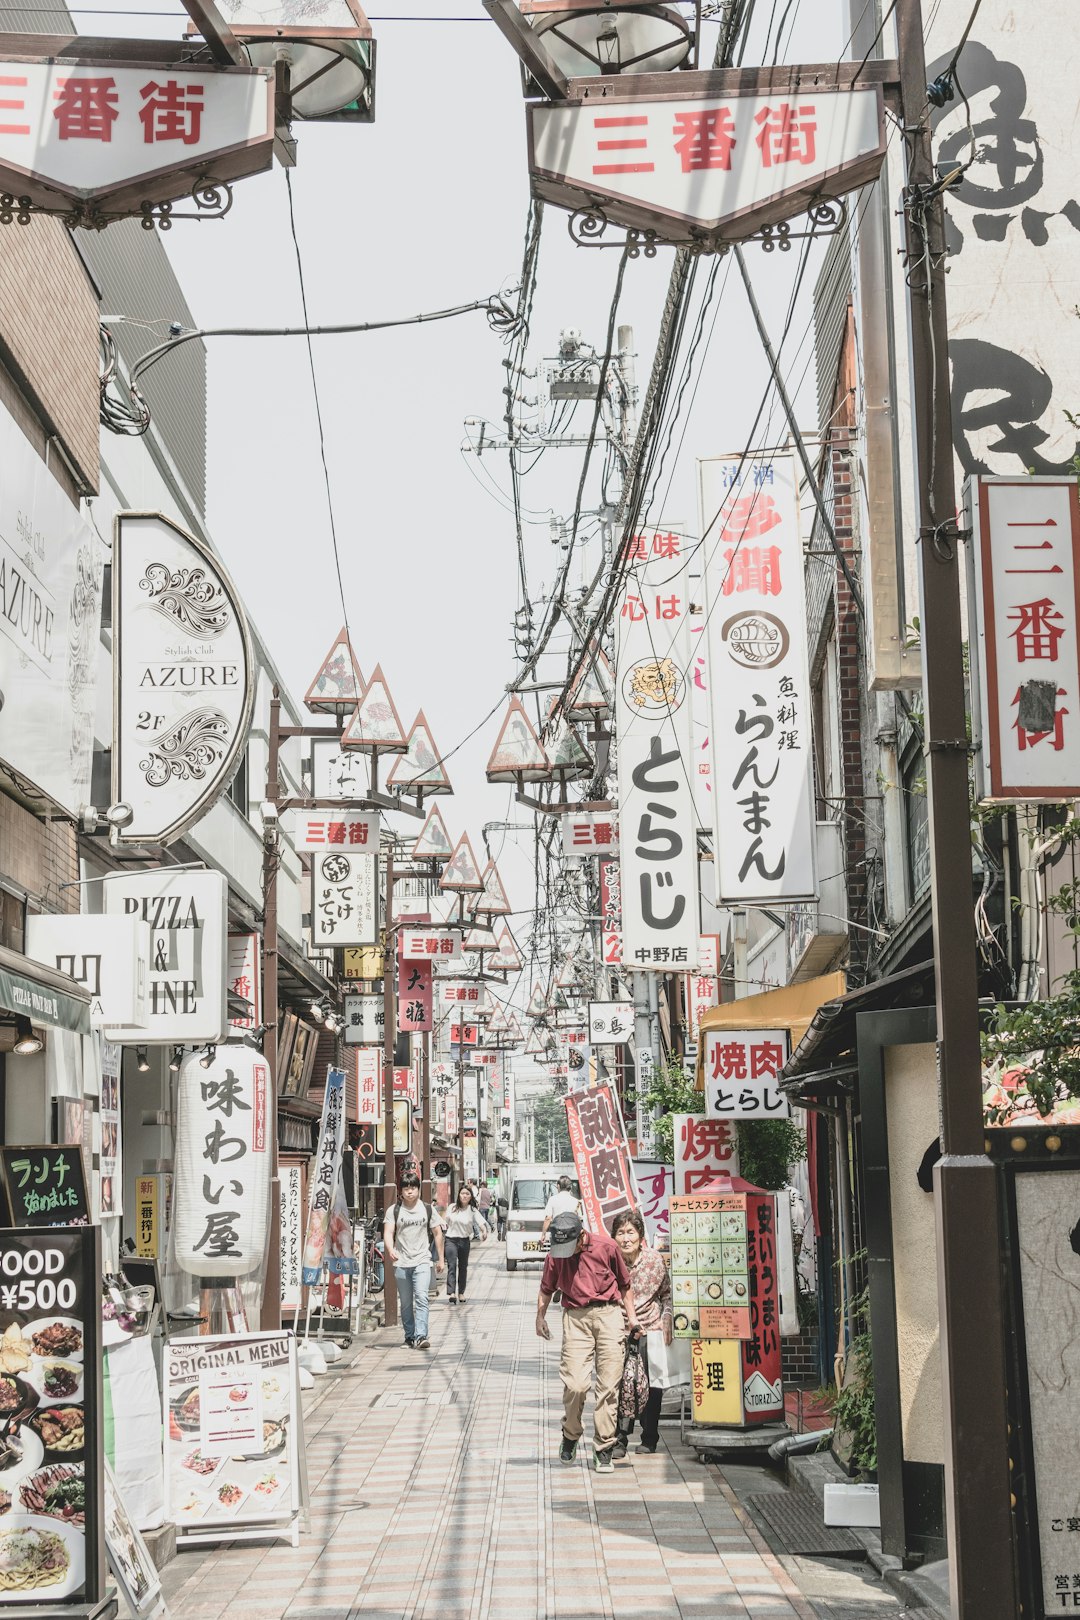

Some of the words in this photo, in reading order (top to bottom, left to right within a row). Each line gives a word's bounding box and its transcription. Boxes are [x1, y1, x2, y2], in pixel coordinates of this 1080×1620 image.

[592, 103, 817, 175] 三番街
[722, 464, 775, 487] 清酒
[164, 645, 193, 657] Stylish
[194, 645, 214, 655] Club
[139, 666, 239, 687] AZURE
[136, 711, 166, 730] 2F
[776, 675, 802, 751] 魚料理
[732, 693, 786, 883] らんまん
[306, 822, 369, 845] 三番街
[631, 735, 687, 930] とらじ
[123, 896, 202, 930] PIZZA
[155, 938, 169, 973] &
[411, 938, 454, 954] 三番街
[634, 947, 688, 963] 中野店
[347, 969, 359, 977] B1
[150, 980, 197, 1015] INE
[445, 988, 479, 1001] 三番街
[560, 1033, 586, 1043] 三番街
[474, 1055, 497, 1064] 三番街
[711, 1040, 783, 1080] 焼肉
[362, 1057, 375, 1114] 三番街
[714, 1088, 784, 1111] とらじ
[11, 1153, 71, 1188] ランチ
[193, 1069, 252, 1258] 味わい屋
[24, 1187, 79, 1216] 始めました
[672, 1199, 726, 1211] サービスランチ
[0, 1249, 65, 1276] OOD
[1, 1279, 77, 1310] ¥500
[169, 1350, 245, 1377] ORIGINAL
[249, 1341, 289, 1362] MENU
[750, 1393, 772, 1406] TORAZI
